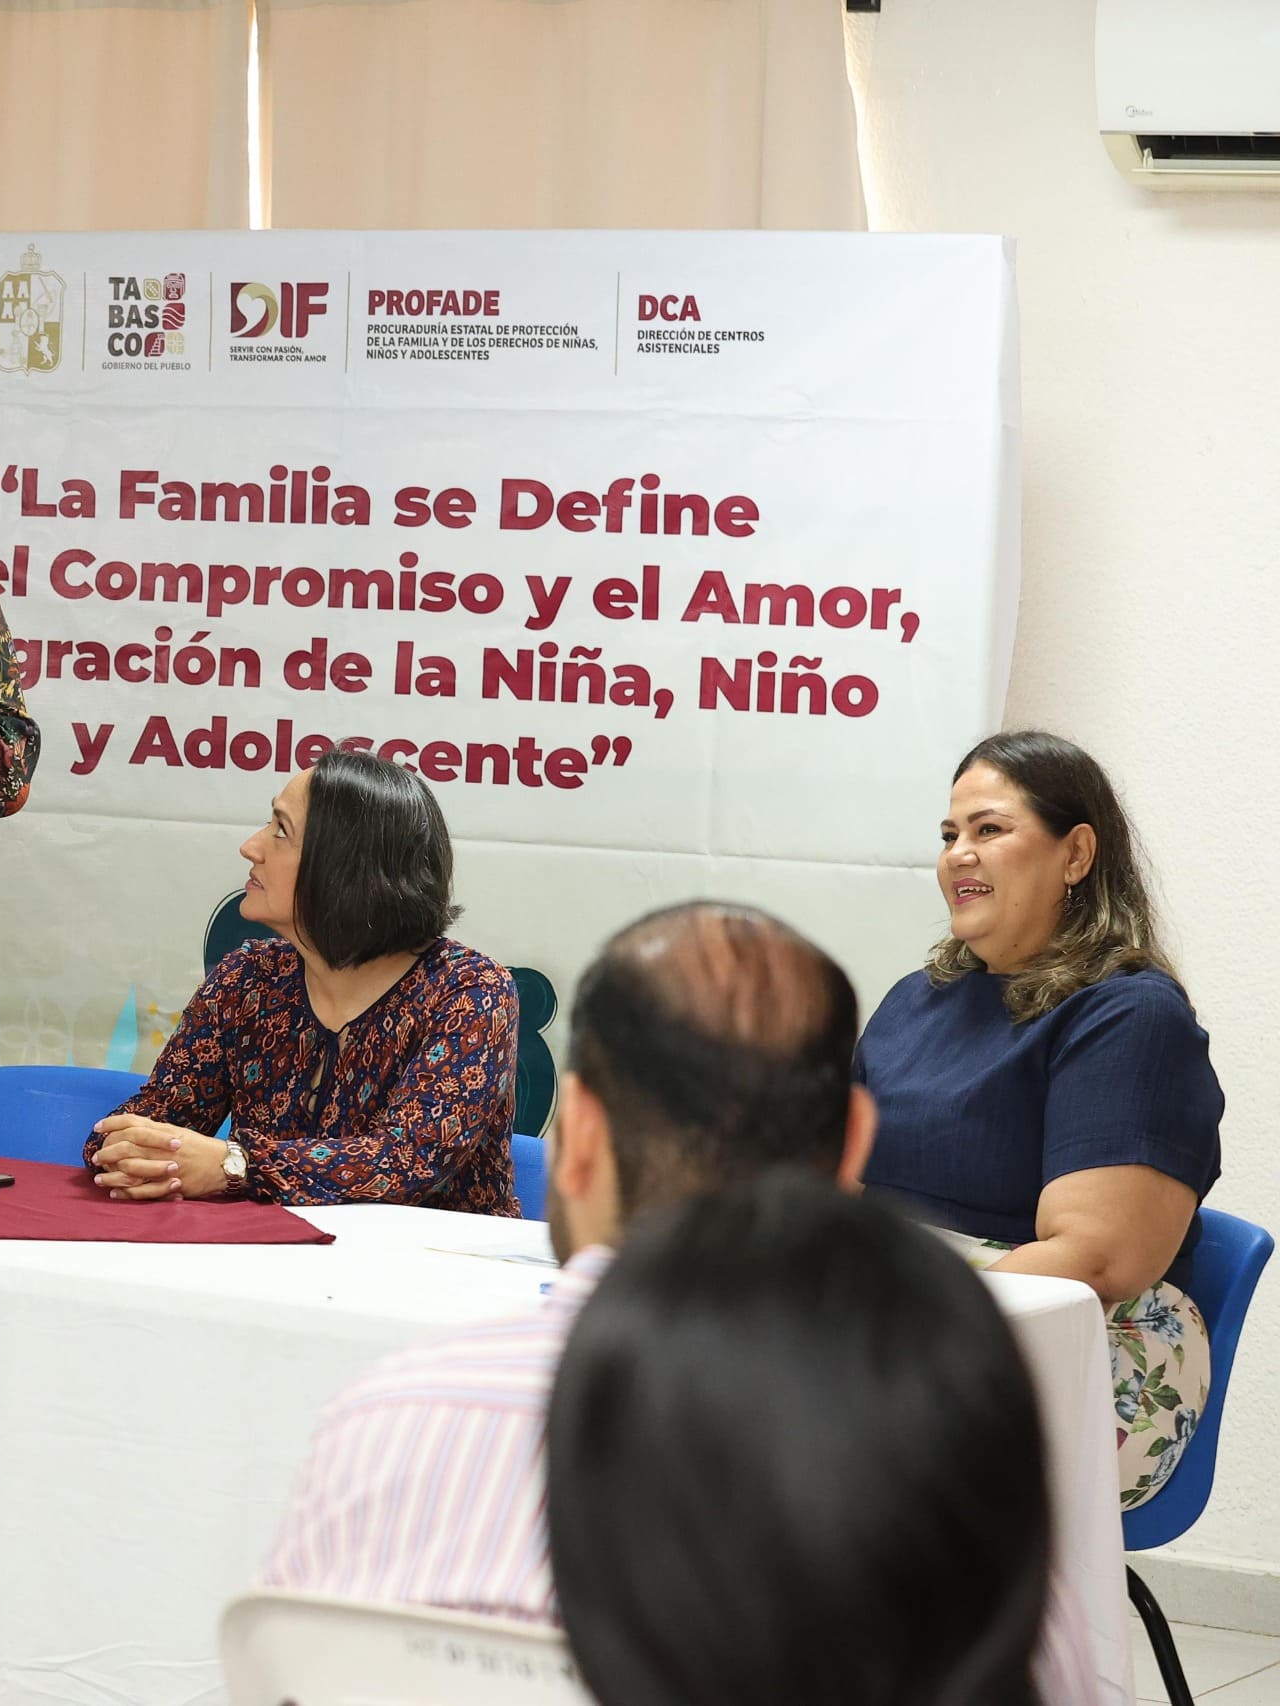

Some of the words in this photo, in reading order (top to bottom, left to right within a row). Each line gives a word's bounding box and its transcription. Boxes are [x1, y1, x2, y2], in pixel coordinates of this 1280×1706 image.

[108, 277, 142, 300] TA
[230, 282, 329, 338] DIF
[368, 290, 500, 316] PROFADE
[638, 294, 701, 321] DCA
[108, 304, 160, 328] BAS
[367, 322, 448, 335] PROCURADURÍA
[451, 324, 493, 335] ESTATAL
[496, 325, 510, 335] DE
[512, 323, 578, 336] PROTECCIÓN
[637, 328, 695, 340] DIRECCIÓN
[698, 331, 711, 340] DE
[714, 331, 765, 341] CENTROS
[107, 332, 143, 357] CO
[229, 346, 254, 354] SERVIR
[256, 346, 273, 354] CON
[366, 347, 398, 360] NIÑOS
[400, 349, 407, 360] Y
[409, 349, 490, 360] ADOLESCENTES
[367, 336, 380, 347] DE
[383, 337, 395, 347] LA
[398, 337, 439, 347] FAMILIA
[442, 337, 449, 347] Y
[451, 337, 465, 347] DE
[467, 337, 486, 348] LOS
[488, 338, 543, 348] DERECHOS
[546, 338, 560, 349] DE
[562, 336, 599, 351] NIÑAS,
[637, 343, 720, 354] ASISTENCIALES
[102, 362, 142, 371] GOBIERNO
[143, 362, 159, 371] DEL
[160, 362, 191, 371] PUEBLO
[229, 354, 284, 362] TRANSFORMAR
[120, 465, 371, 526] Familia
[394, 486, 477, 529] se
[500, 473, 760, 538] Define
[50, 548, 505, 618] Compromiso
[524, 575, 572, 631] y
[593, 565, 661, 621] el
[681, 570, 921, 644] Amor,
[283, 637, 373, 694] de
[394, 640, 457, 697] la
[482, 641, 675, 720] Niña,
[698, 650, 880, 718] Niño
[70, 721, 115, 776] y
